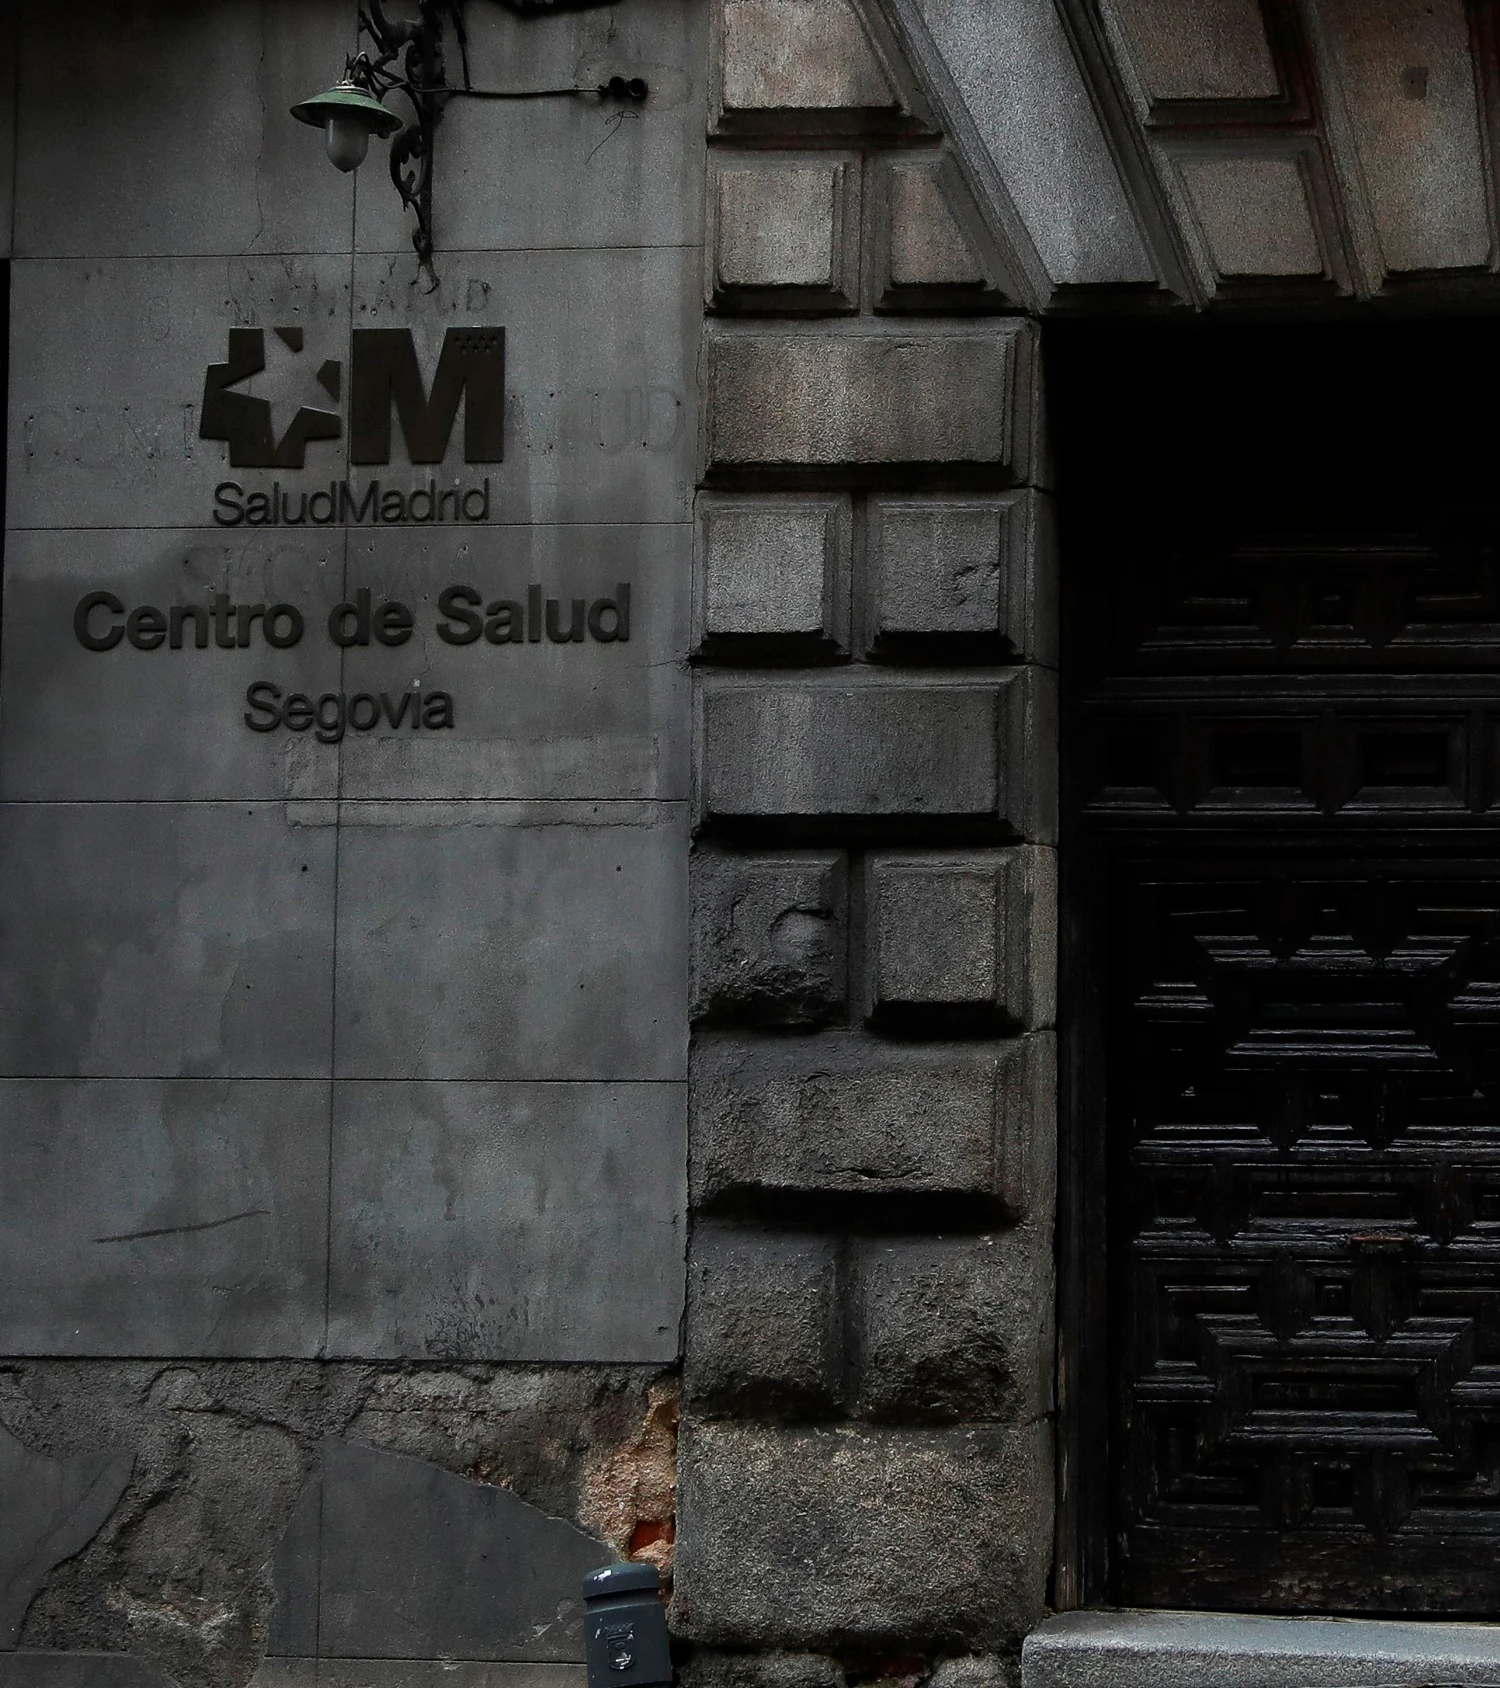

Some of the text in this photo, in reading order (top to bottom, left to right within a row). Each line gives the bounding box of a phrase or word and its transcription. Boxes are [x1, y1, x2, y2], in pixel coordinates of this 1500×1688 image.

[351, 326, 505, 465] M
[213, 477, 490, 526] SaludMadrid
[74, 583, 631, 652] Centro de Salud
[244, 681, 455, 744] Segovia
